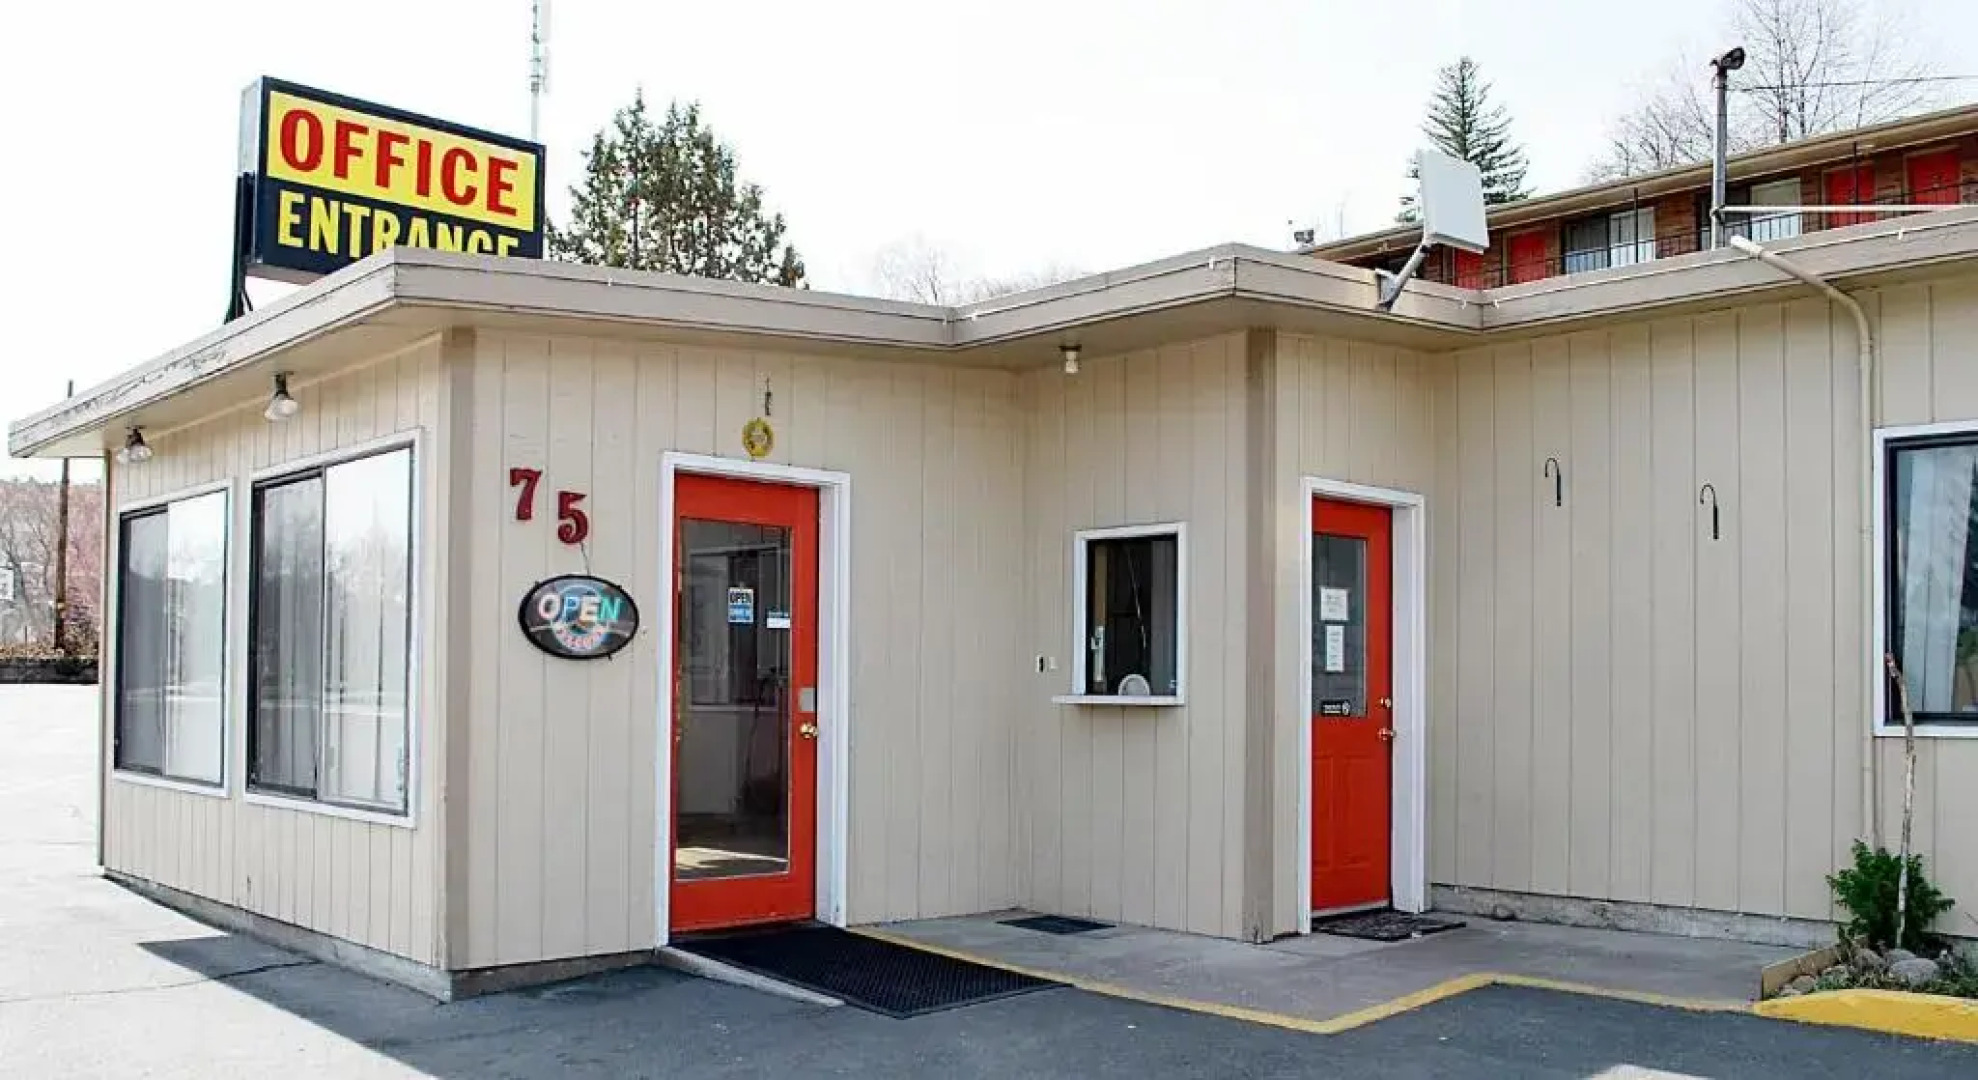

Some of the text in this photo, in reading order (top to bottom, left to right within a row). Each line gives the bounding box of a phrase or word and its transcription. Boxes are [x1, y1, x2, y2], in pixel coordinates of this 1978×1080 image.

[279, 108, 519, 216] OFFICE
[538, 594, 621, 622] OPEN
[729, 592, 751, 604] OPEN
